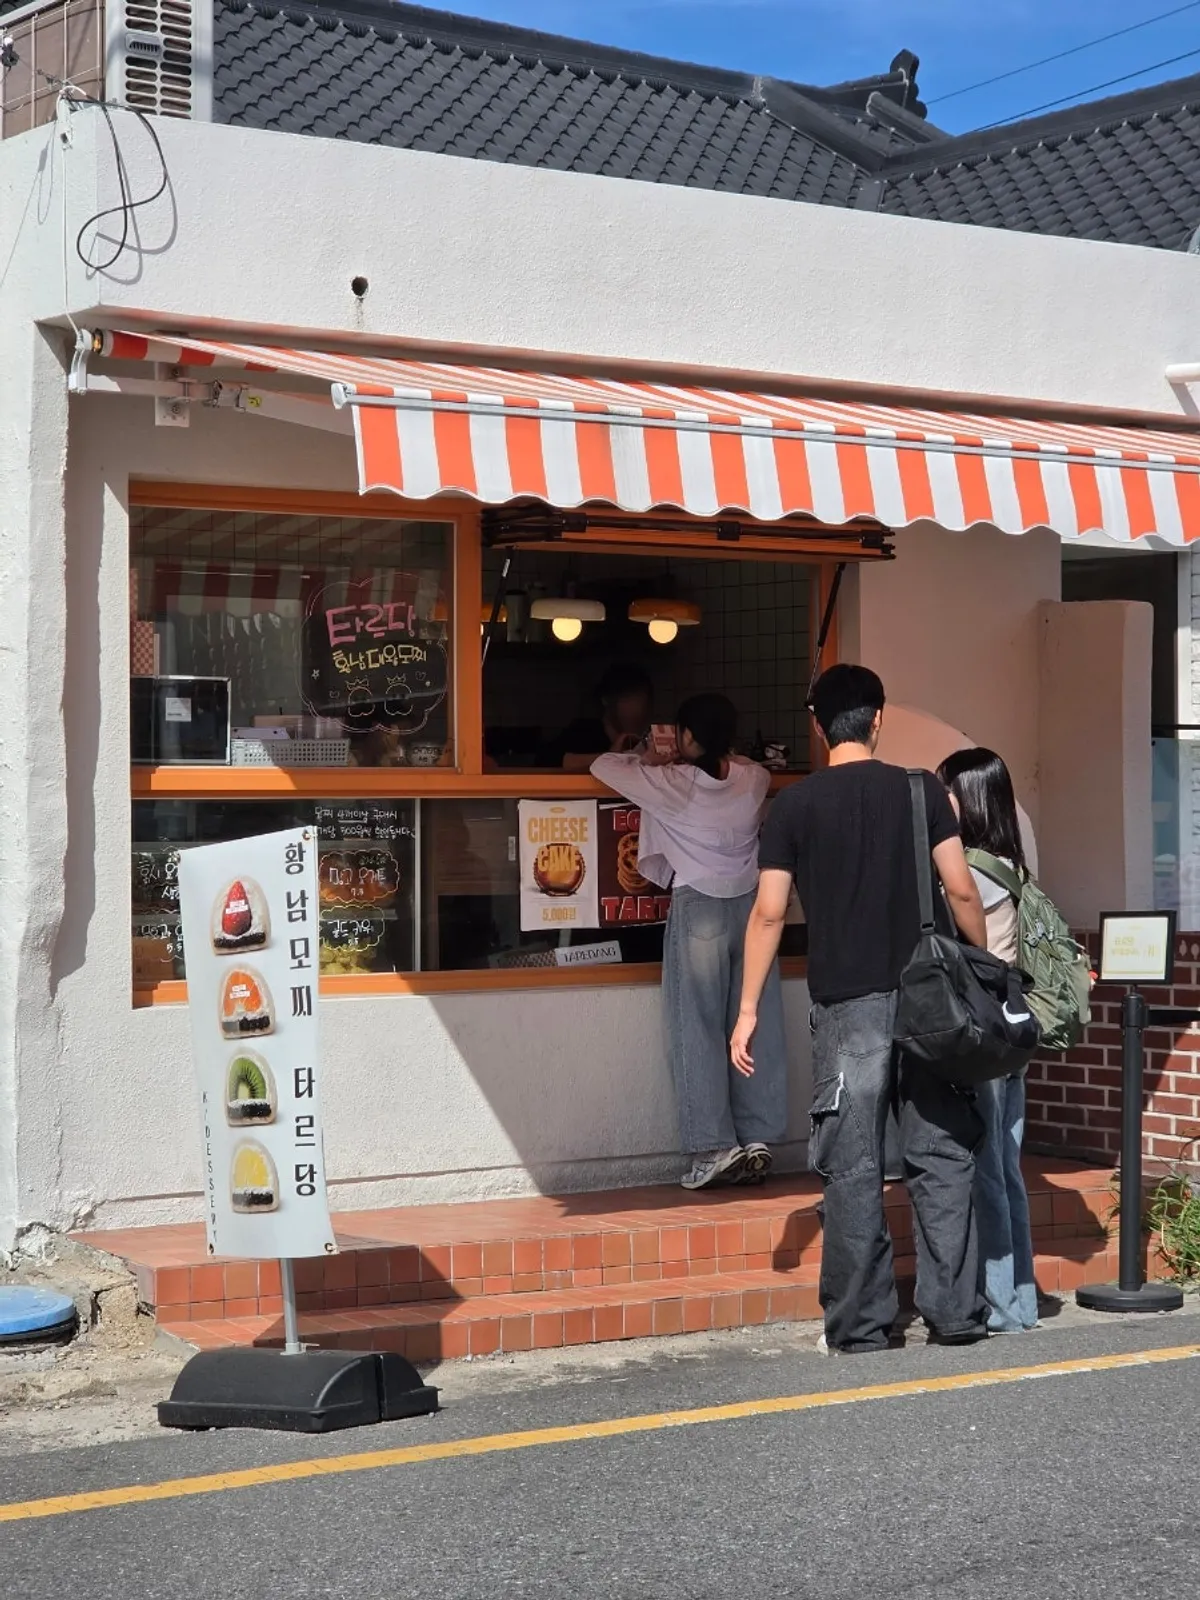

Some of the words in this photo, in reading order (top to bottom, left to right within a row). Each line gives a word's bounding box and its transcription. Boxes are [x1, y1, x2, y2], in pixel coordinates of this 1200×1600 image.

[325, 602, 417, 648] 타르당
[332, 644, 427, 674] 황남대왕모찌
[527, 816, 589, 843] CHEESE
[612, 809, 642, 831] EG
[537, 844, 581, 872] CAKE
[284, 841, 312, 1018] 황남모찌
[293, 1066, 319, 1197] 타르당
